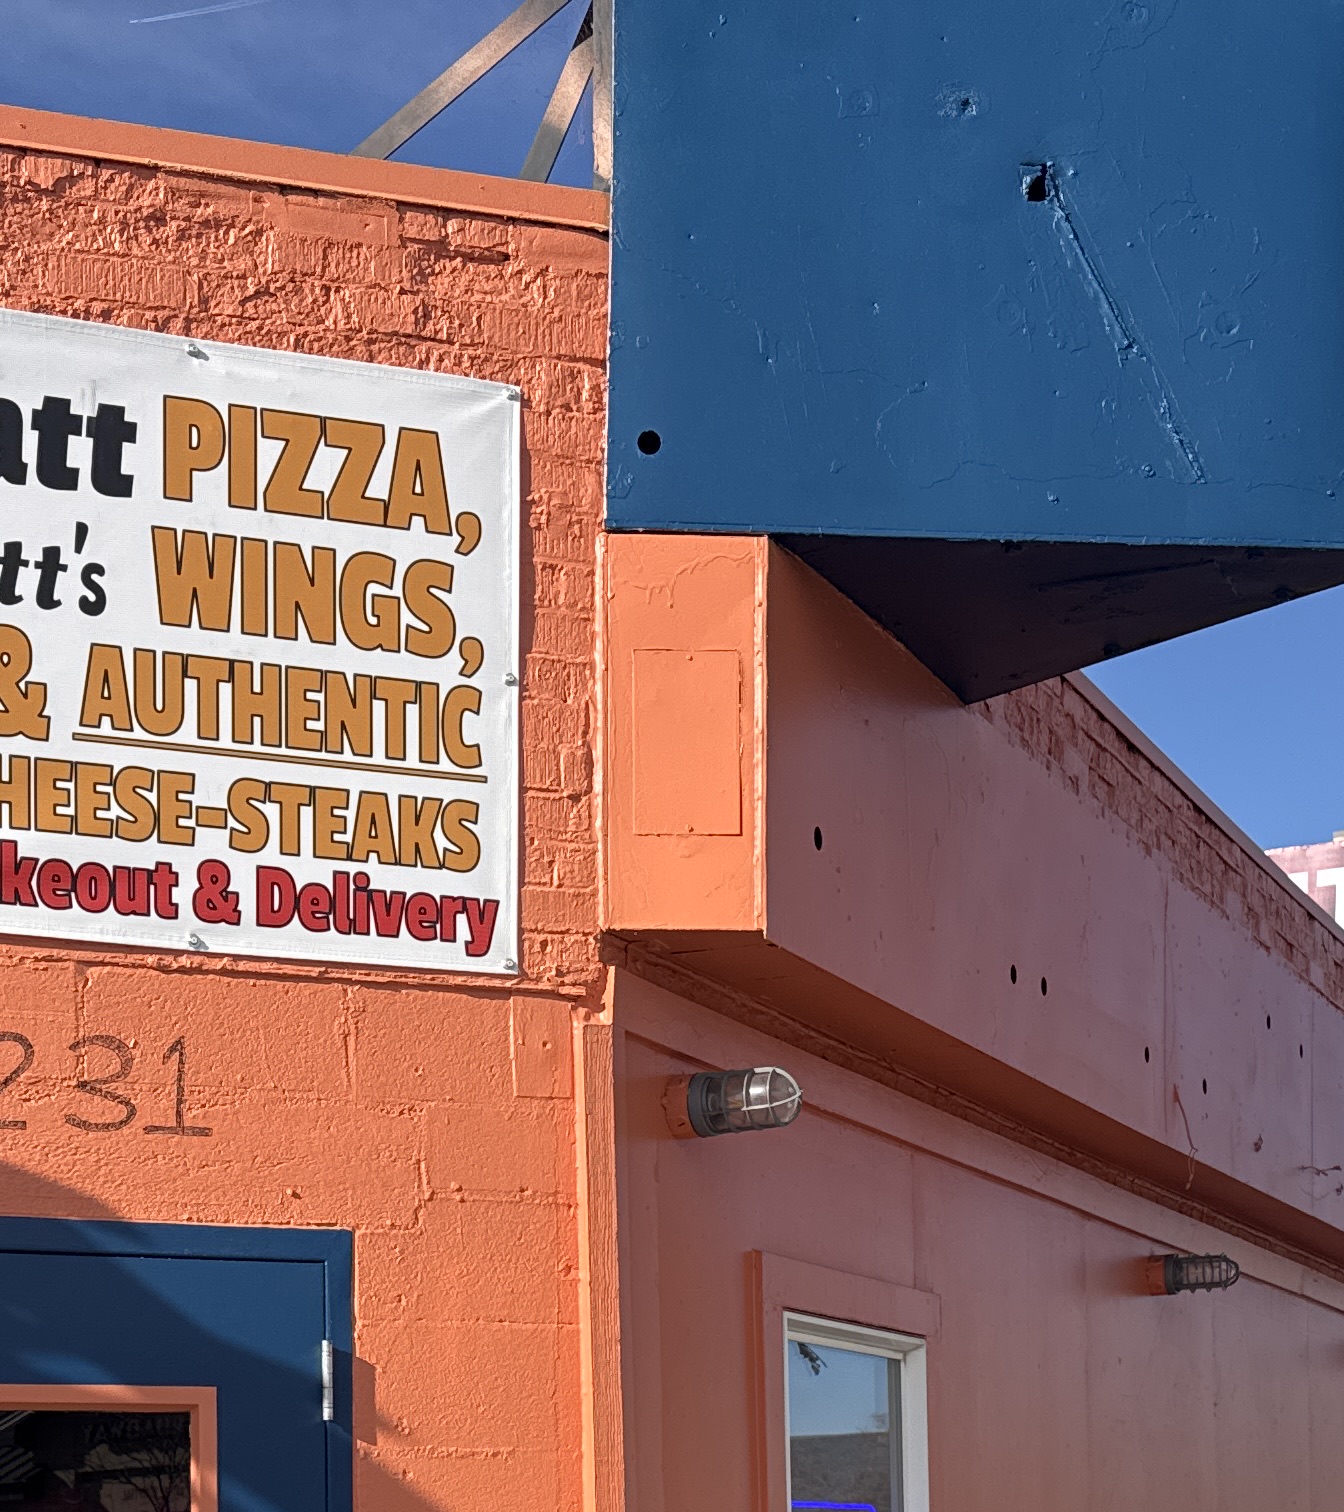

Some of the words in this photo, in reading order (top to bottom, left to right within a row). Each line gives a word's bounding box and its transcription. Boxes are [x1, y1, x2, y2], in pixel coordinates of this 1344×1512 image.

[163, 394, 482, 557] PIZZA,
[151, 525, 485, 680] WINGS,
[79, 642, 484, 769] AUTHENTIC
[192, 859, 241, 926] &
[256, 866, 500, 957] Delivery
